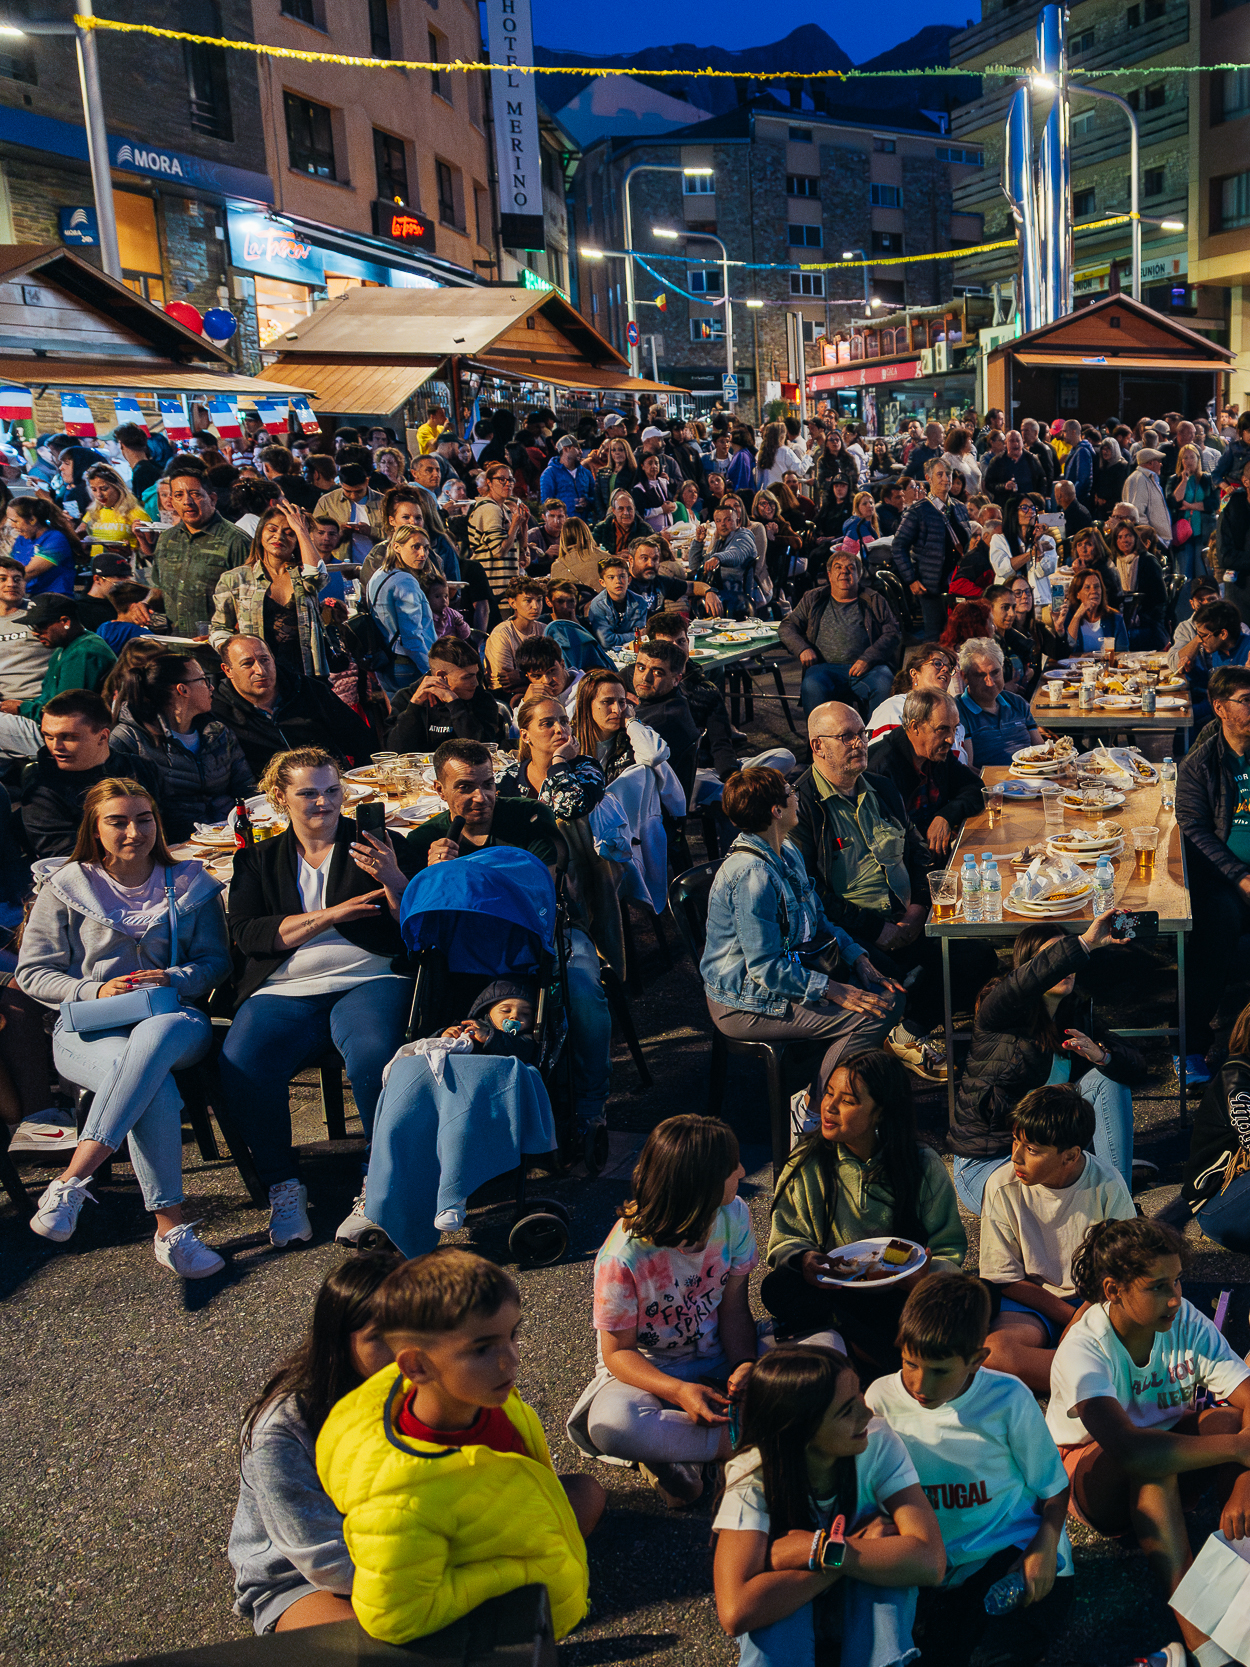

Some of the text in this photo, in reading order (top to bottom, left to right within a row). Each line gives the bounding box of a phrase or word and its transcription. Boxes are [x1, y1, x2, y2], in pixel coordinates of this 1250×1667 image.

[502, 0, 520, 88] HOTEL
[506, 101, 528, 207] MERINO
[660, 1289, 698, 1325] FREE
[674, 1287, 715, 1338] SPIRIT
[1168, 1357, 1195, 1385] YOU
